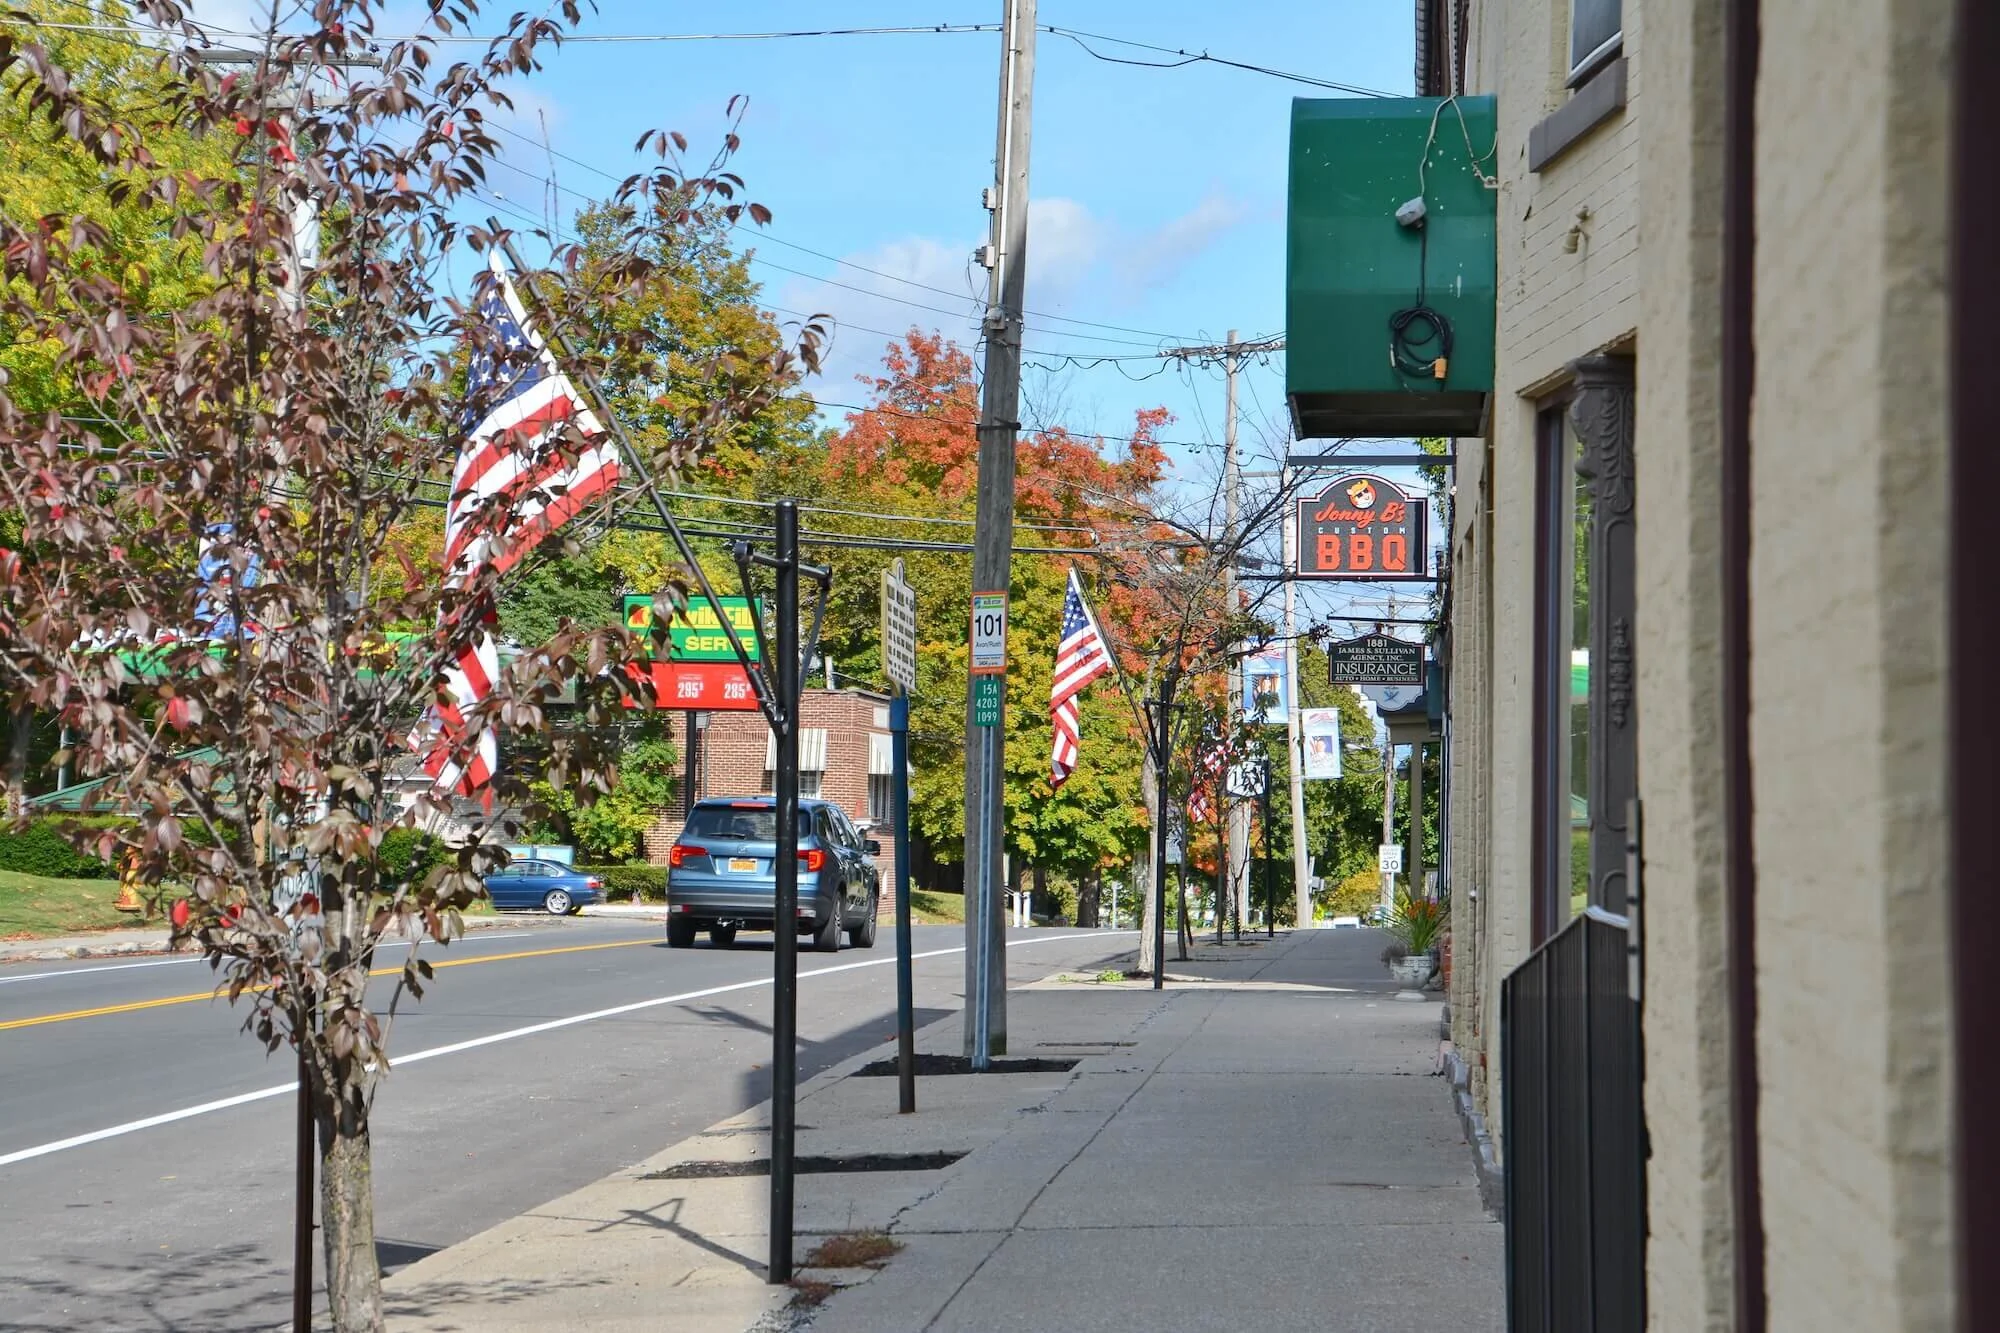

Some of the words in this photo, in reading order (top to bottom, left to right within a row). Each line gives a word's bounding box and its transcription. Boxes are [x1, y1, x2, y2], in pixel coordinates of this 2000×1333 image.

[1315, 502, 1376, 529] Jonny
[1380, 501, 1407, 524] B's
[1318, 526, 1406, 535] CUSTOM
[1316, 534, 1408, 572] BBQ
[974, 613, 1002, 637] 101
[1367, 639, 1387, 648] 1881
[1374, 647, 1416, 655] SULLIVAN
[1336, 662, 1417, 675] INSURANCE
[983, 683, 998, 695] 15A
[976, 697, 998, 709] 4203
[977, 711, 998, 722] 1099
[1382, 860, 1399, 870] 30
